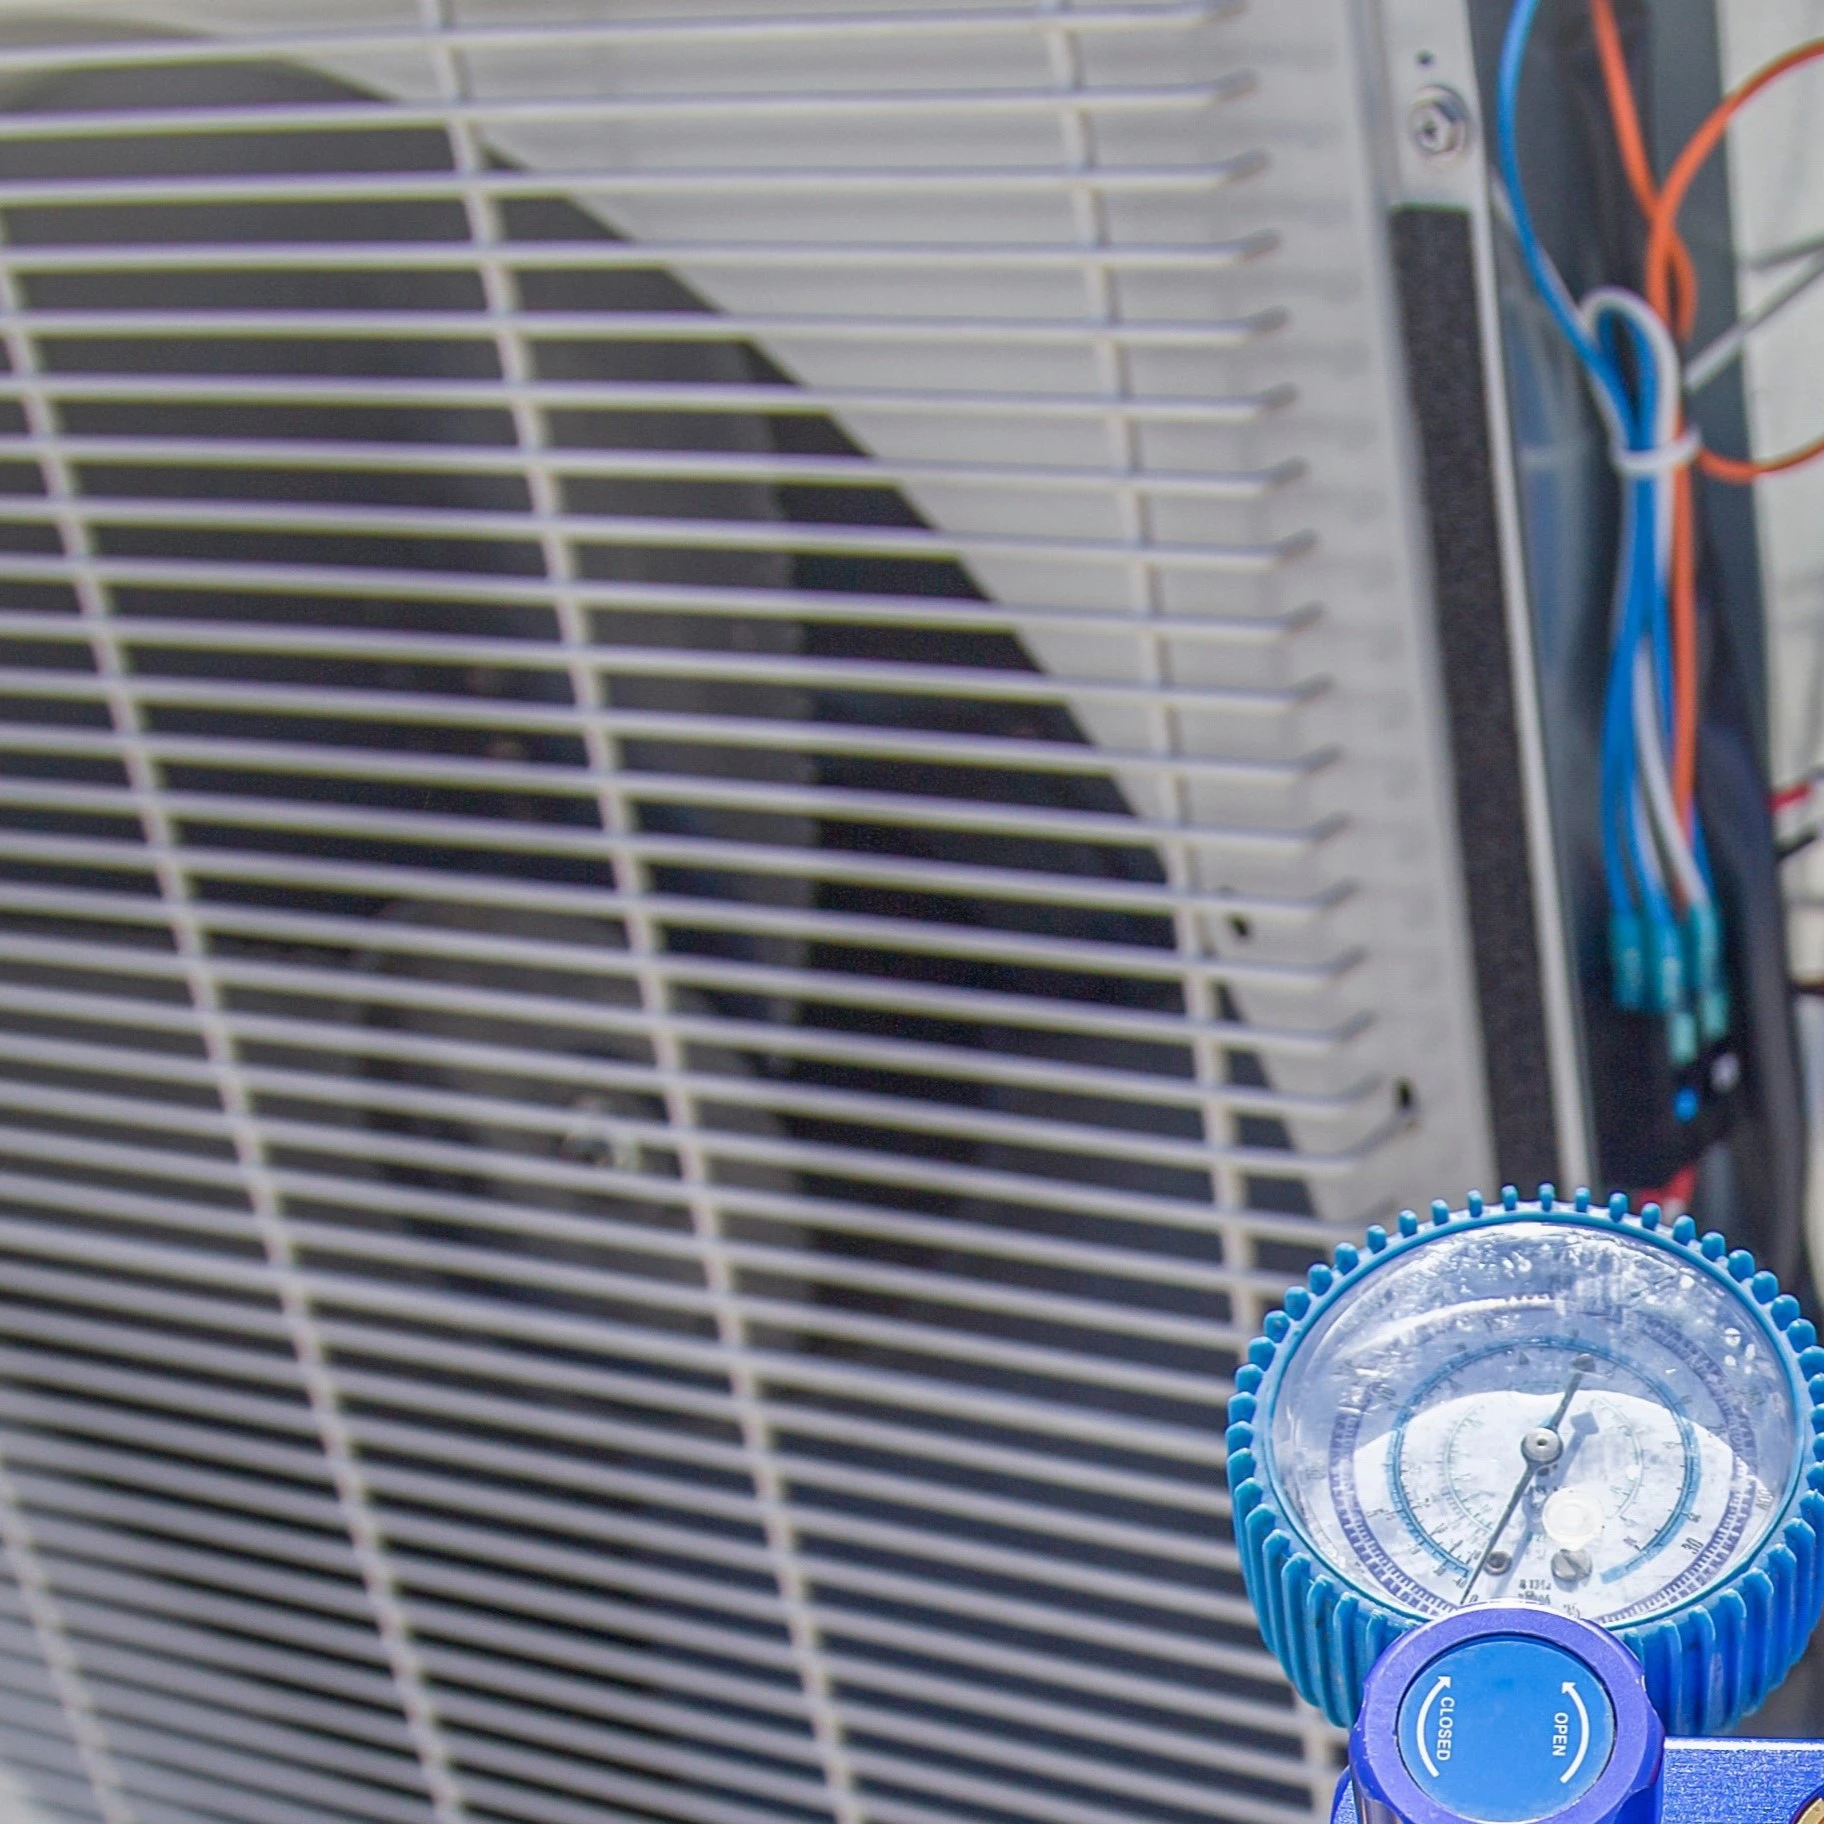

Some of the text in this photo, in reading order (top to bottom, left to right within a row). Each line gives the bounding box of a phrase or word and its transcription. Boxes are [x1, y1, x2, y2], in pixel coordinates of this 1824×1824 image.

[1681, 1537, 1704, 1555] 30
[1437, 1696, 1455, 1761] CLOSED
[1552, 1711, 1569, 1757] OPEN
